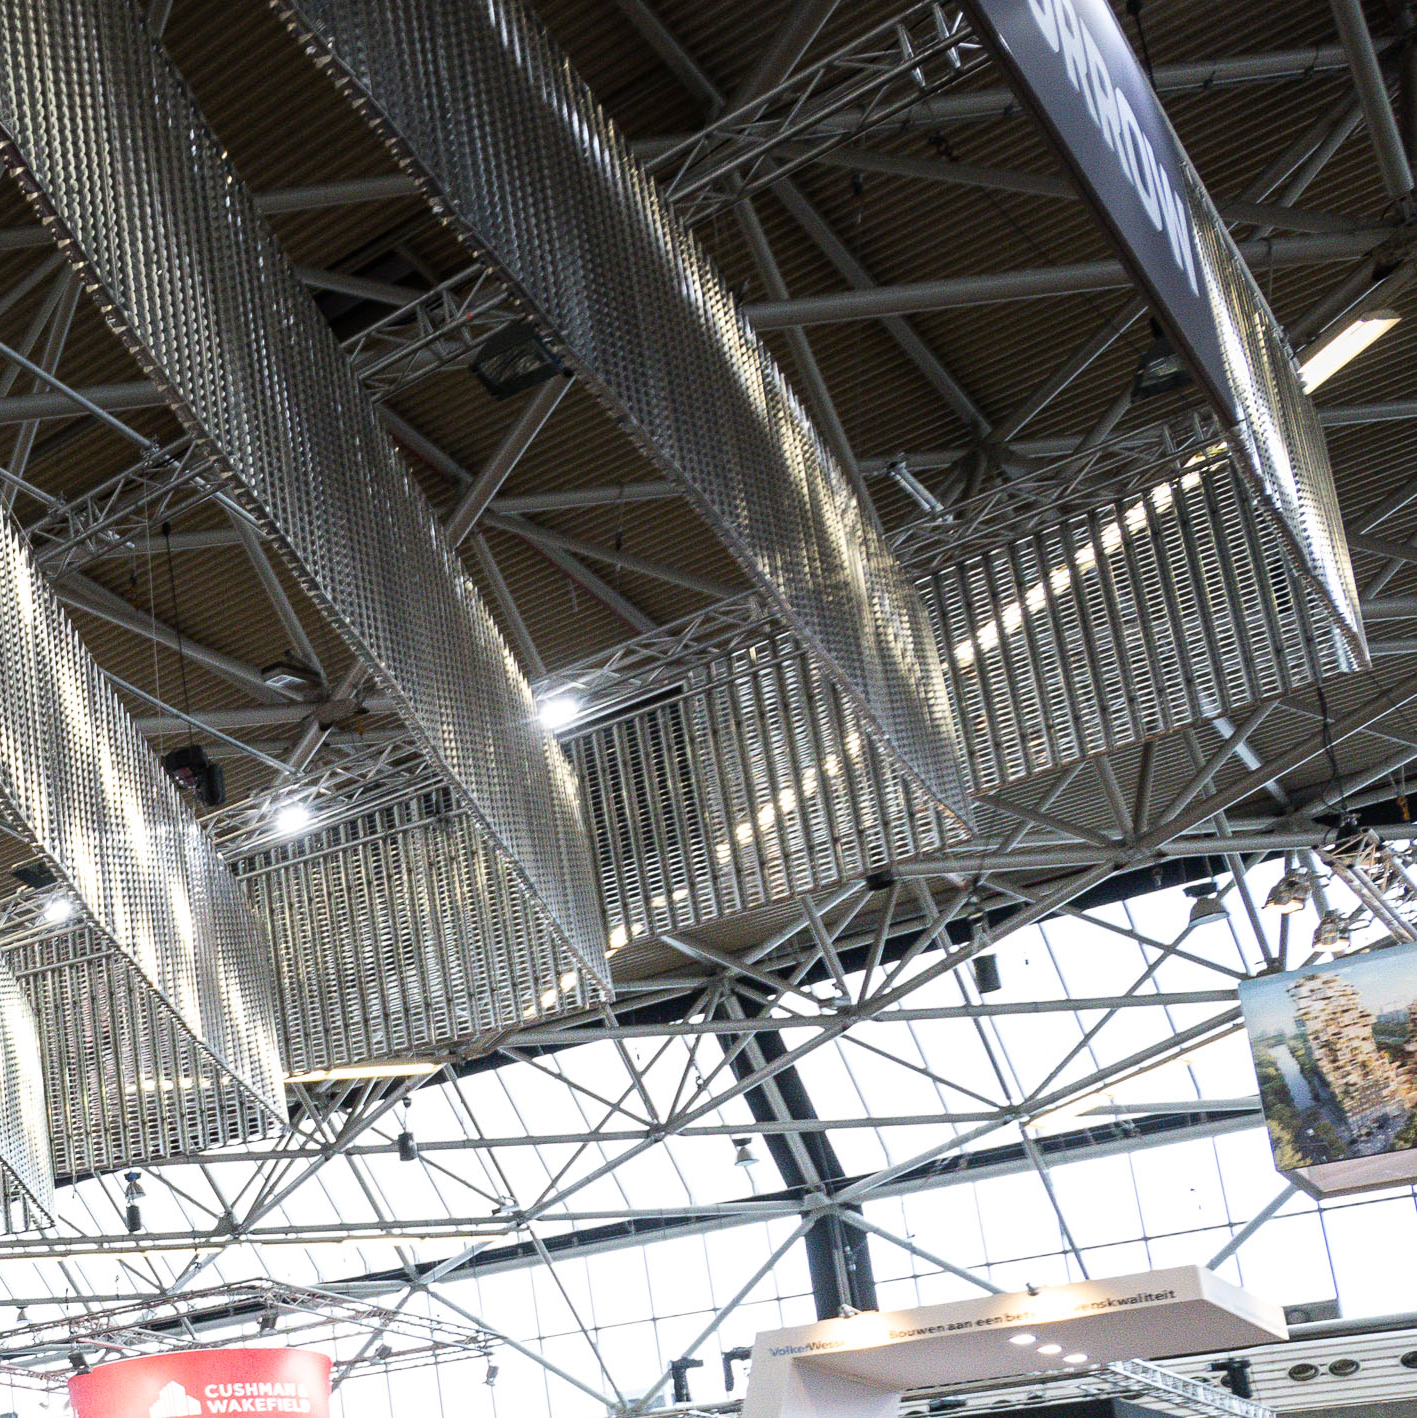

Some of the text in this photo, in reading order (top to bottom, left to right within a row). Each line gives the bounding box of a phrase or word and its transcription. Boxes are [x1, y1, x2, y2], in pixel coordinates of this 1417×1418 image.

[948, 1315, 973, 1331] aan
[976, 1311, 1003, 1327] een
[205, 1382, 296, 1397] CUSHMAN
[206, 1398, 310, 1414] WAKEFIELD
